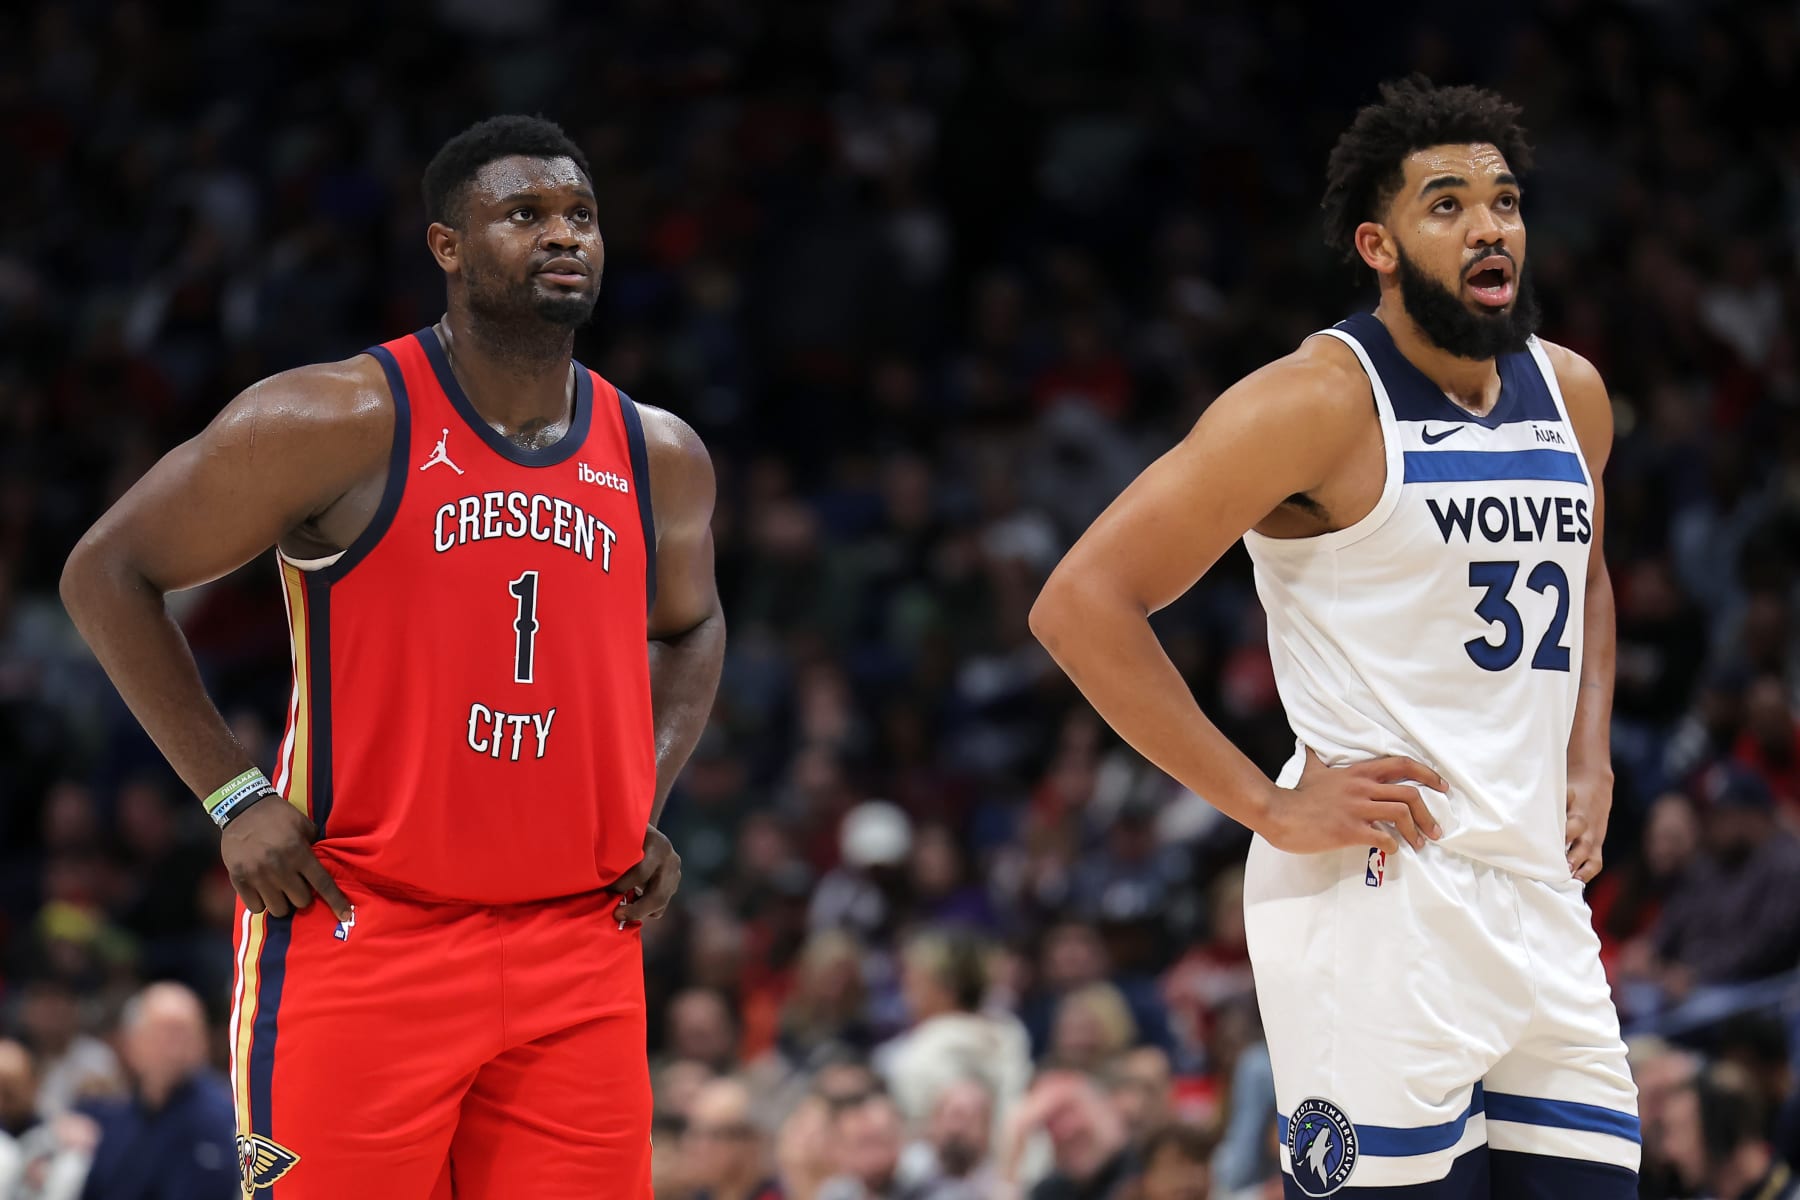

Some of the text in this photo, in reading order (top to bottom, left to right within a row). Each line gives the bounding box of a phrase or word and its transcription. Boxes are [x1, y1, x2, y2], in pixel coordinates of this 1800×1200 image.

[578, 462, 629, 493] ibotta
[433, 491, 617, 573] CRESCENT
[1426, 496, 1592, 544] WOLVES
[508, 570, 539, 684] 1
[1464, 560, 1571, 672] 32
[467, 702, 556, 761] CITY
[1288, 1101, 1354, 1182] MINNESOTA TIMBERWOLVES
